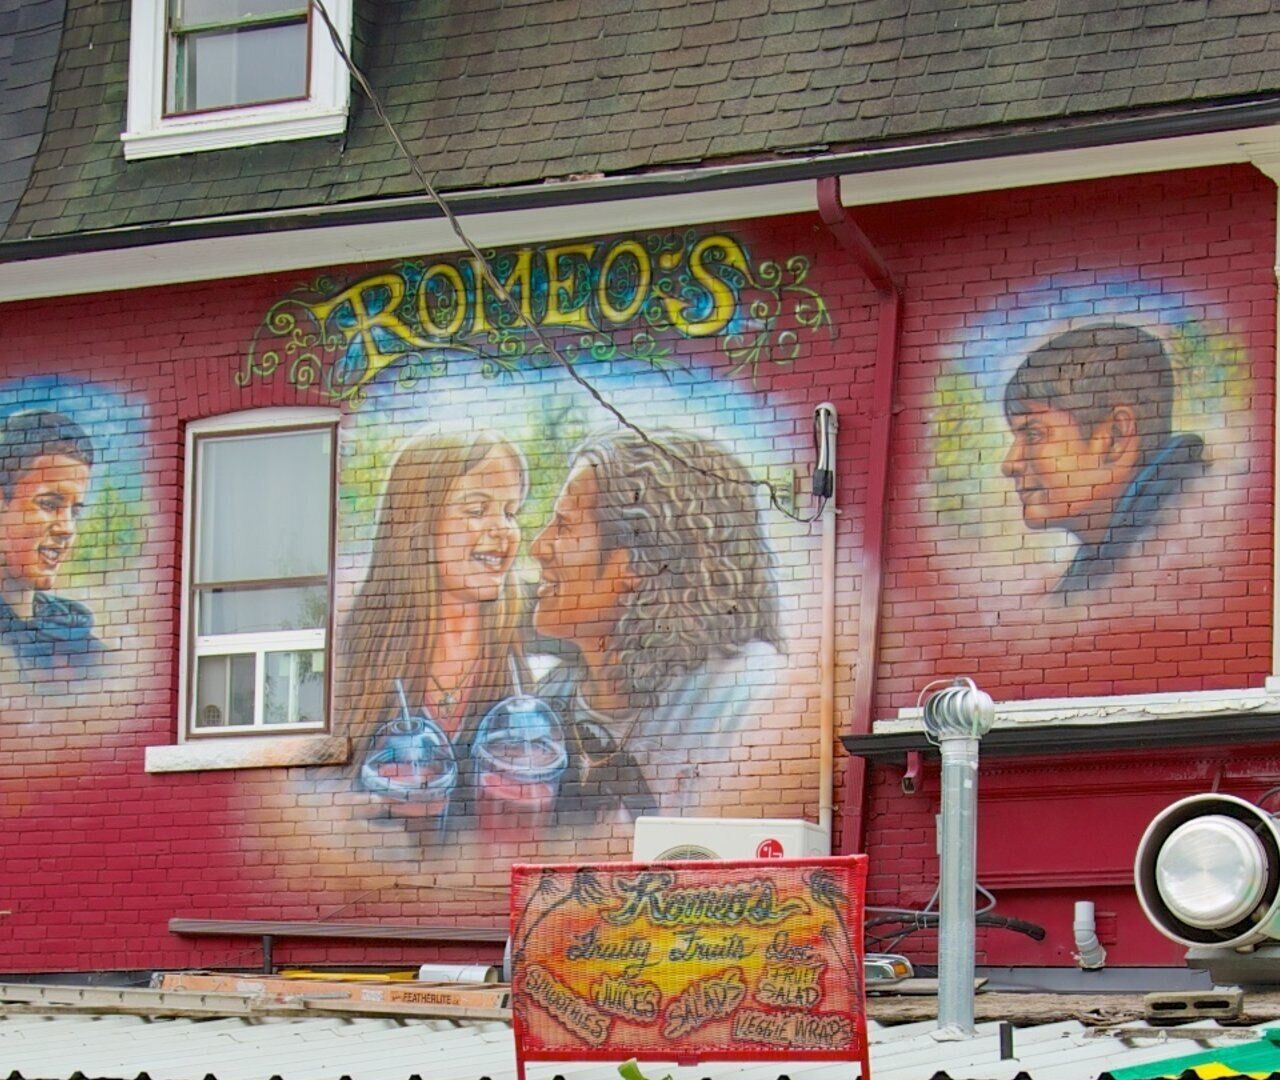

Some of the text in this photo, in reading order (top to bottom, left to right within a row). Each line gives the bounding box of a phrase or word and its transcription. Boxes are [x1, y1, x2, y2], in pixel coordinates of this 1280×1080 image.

[310, 234, 756, 383] ROMEO'S
[605, 872, 808, 926] Romeo's
[595, 979, 659, 1016] JUICES
[734, 1014, 852, 1045] VEGGIE WRAPS
